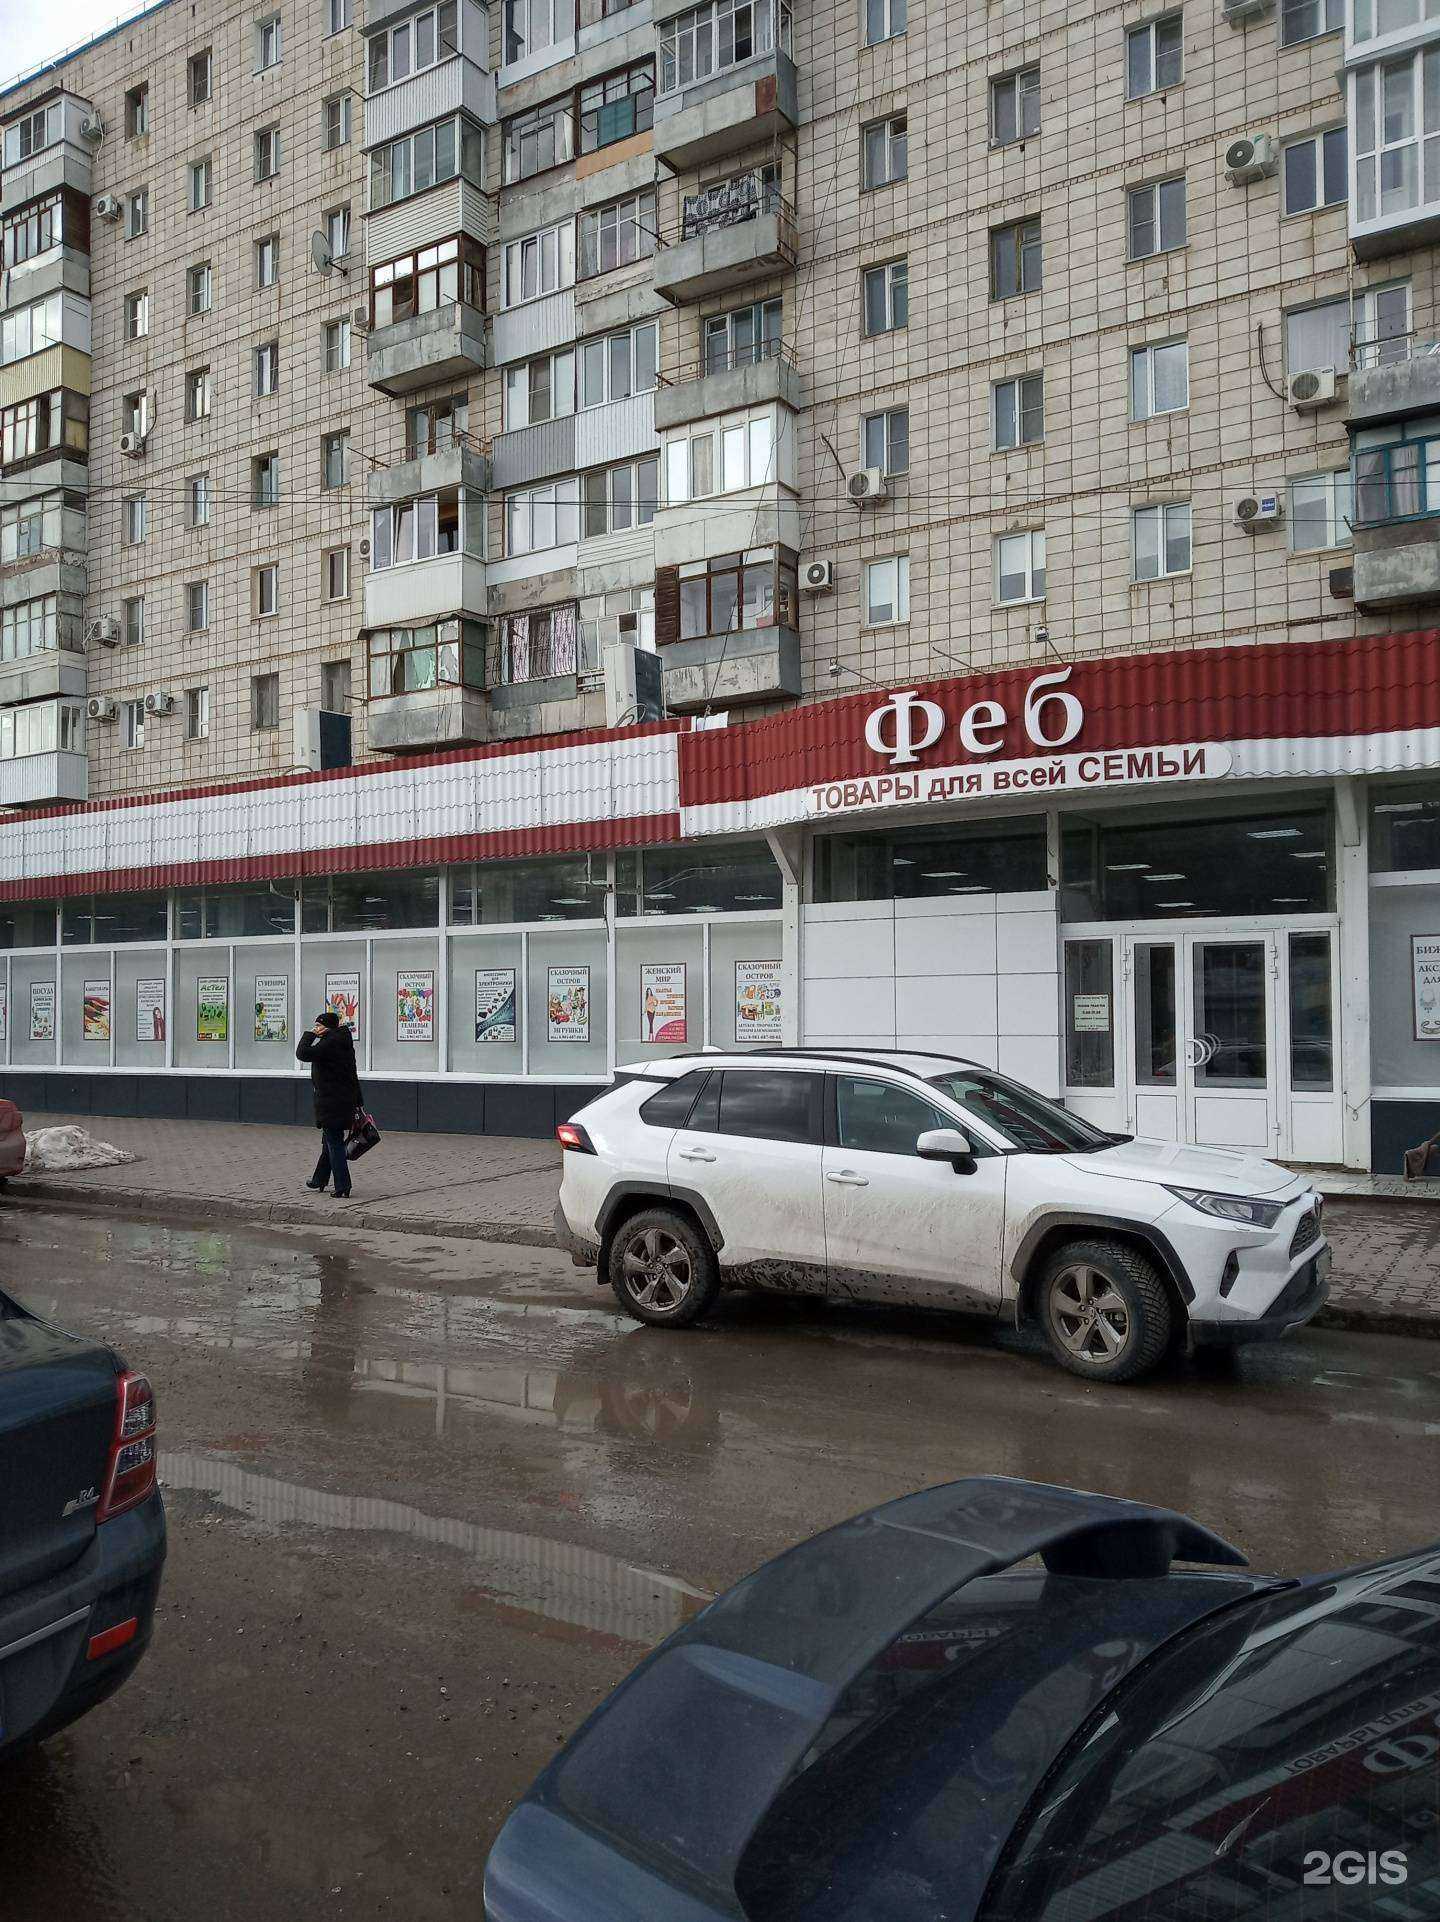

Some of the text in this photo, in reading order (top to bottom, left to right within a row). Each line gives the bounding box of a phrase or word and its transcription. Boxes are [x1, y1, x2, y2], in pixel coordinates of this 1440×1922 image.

[865, 665, 1084, 765] Феб
[813, 748, 1206, 811] ТОВАРЫ для всей СЕМЬИ
[645, 966, 682, 975] ЖЕНСКИЙ
[737, 962, 782, 971] СКАЗОЧНЫЙ
